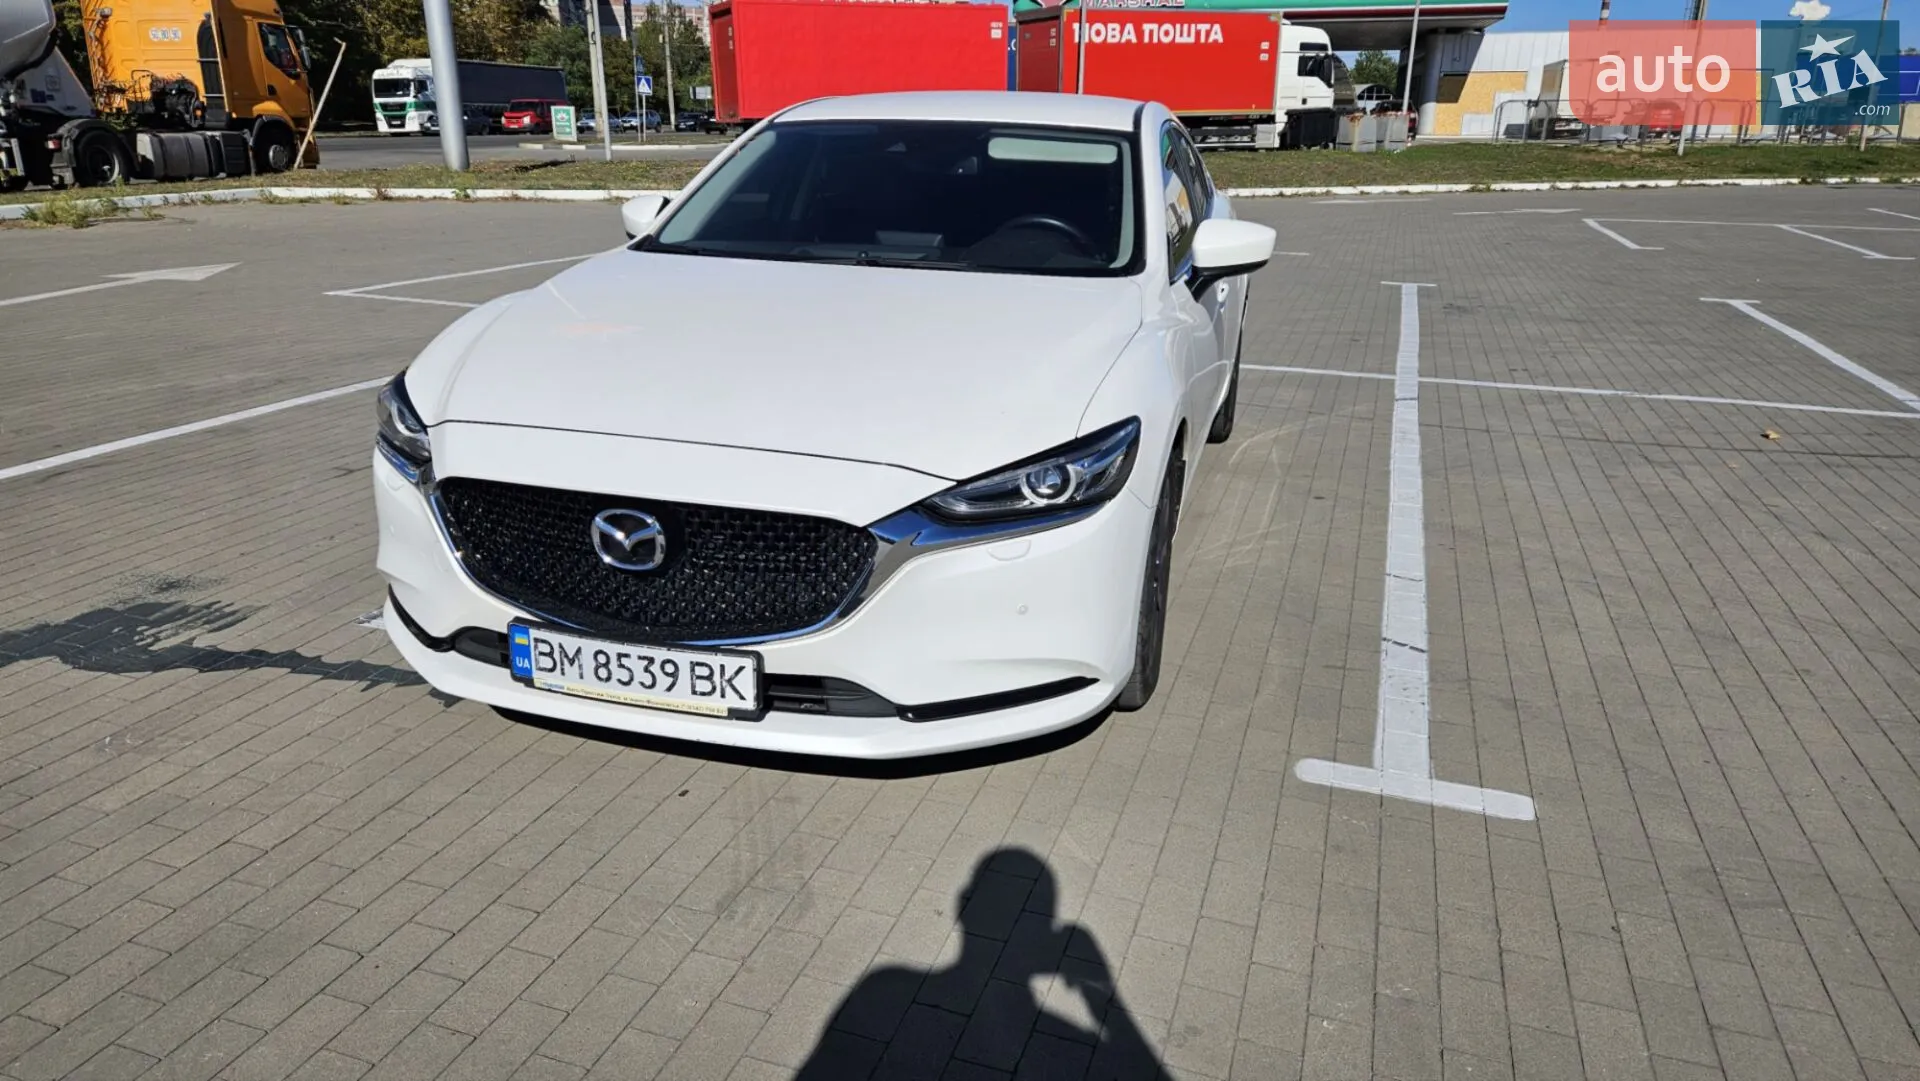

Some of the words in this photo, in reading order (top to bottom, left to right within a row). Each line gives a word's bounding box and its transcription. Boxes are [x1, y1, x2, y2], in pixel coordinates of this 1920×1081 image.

[1142, 23, 1224, 44] ПОШТА
[516, 657, 531, 670] UA
[533, 637, 584, 680] BM
[592, 649, 680, 693] 8539
[689, 660, 746, 701] BK
